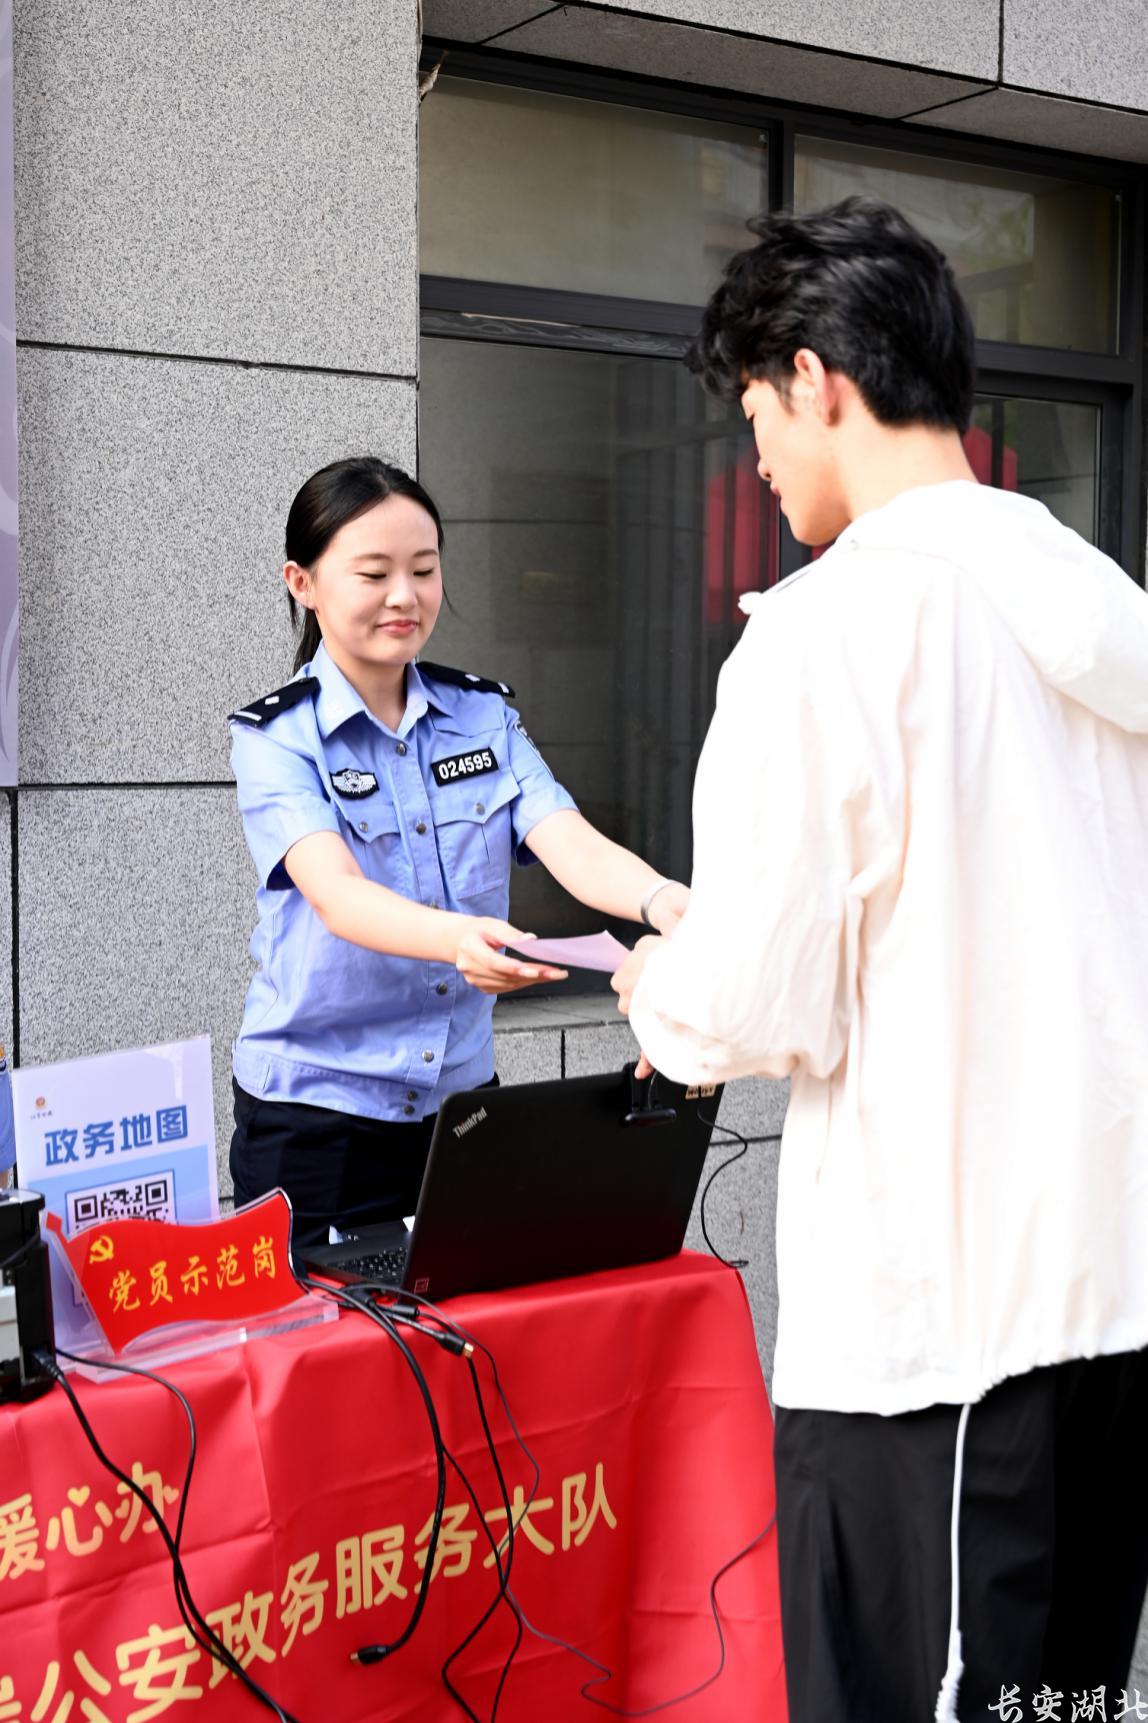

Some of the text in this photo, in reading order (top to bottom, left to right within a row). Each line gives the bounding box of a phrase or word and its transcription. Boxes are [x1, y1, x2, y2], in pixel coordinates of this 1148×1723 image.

[438, 751, 492, 780] 024595
[44, 1105, 189, 1167] 政务地图
[453, 1106, 487, 1138] ThinkPad
[108, 1236, 277, 1313] 党员示范岗
[0, 1463, 618, 1723] 公安政务服务大队
